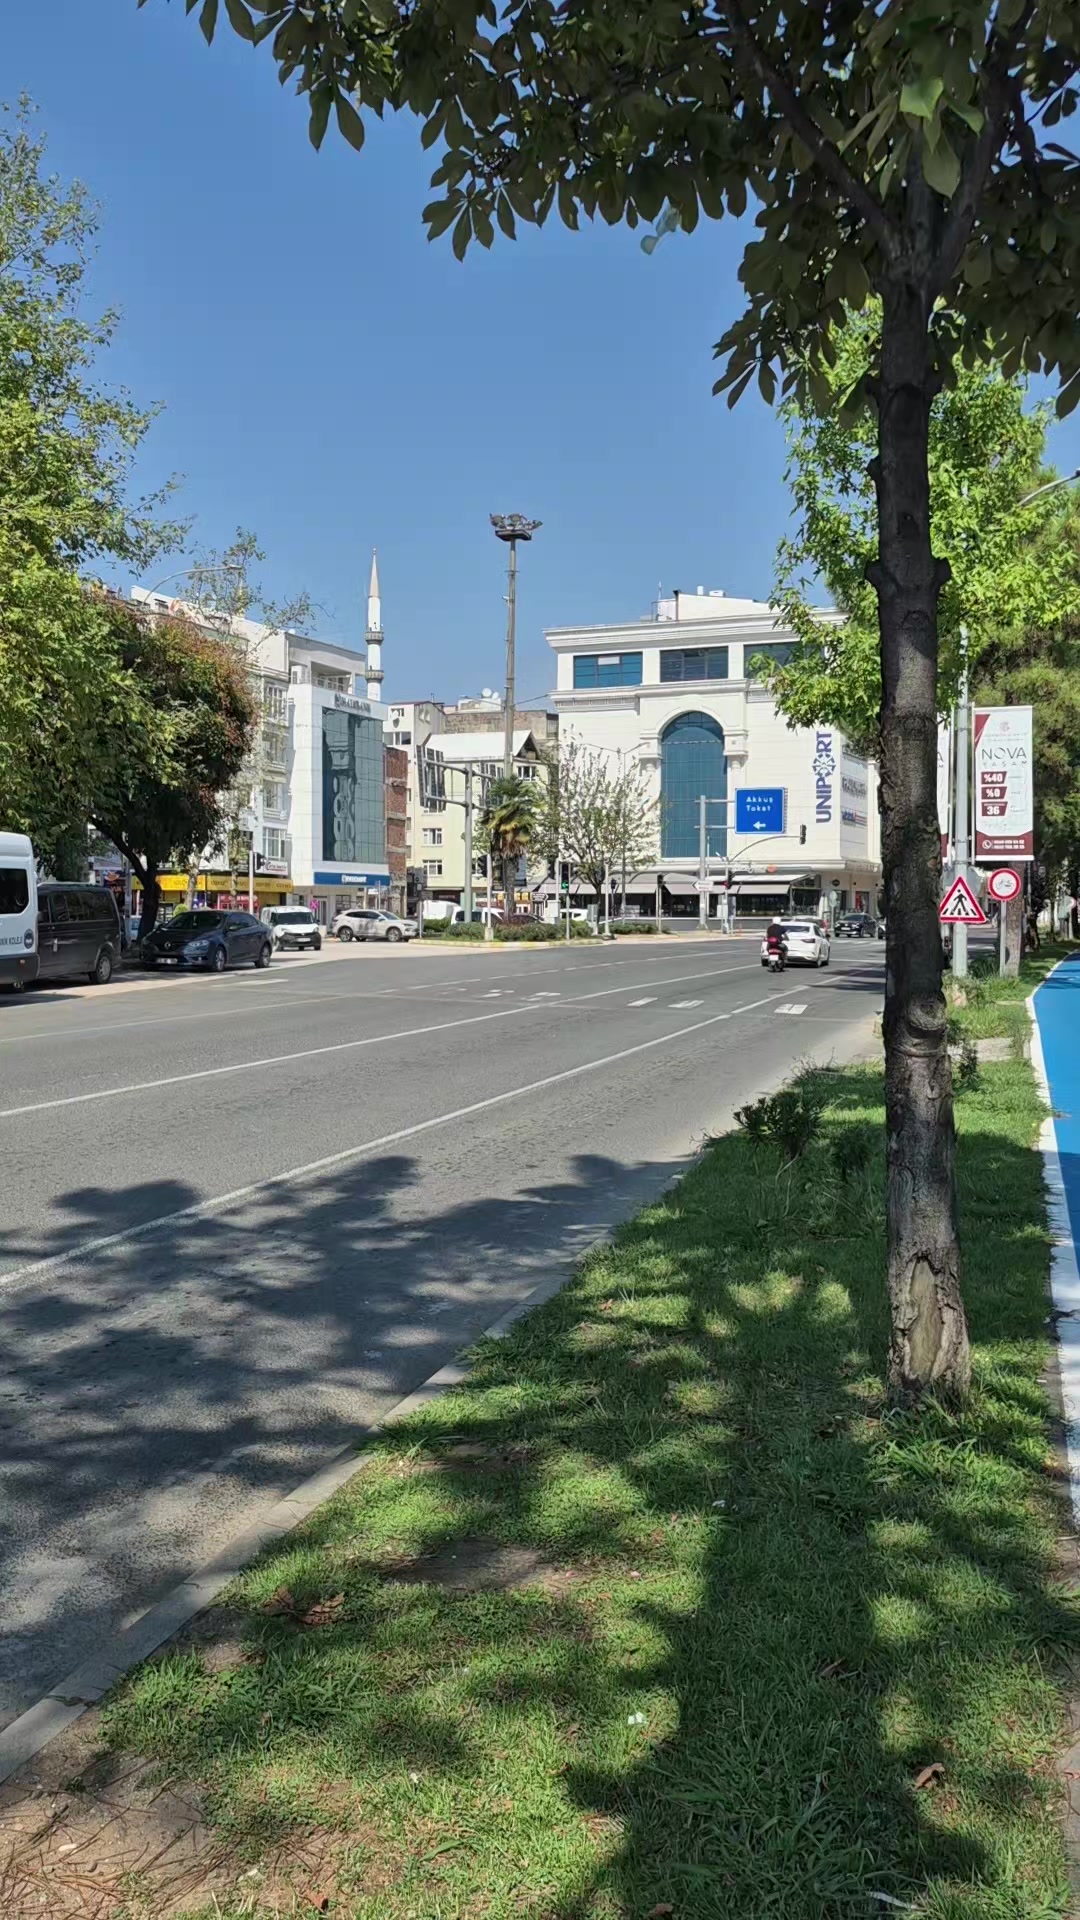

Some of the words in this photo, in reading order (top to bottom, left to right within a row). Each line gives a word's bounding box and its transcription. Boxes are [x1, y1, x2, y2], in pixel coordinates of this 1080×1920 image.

[981, 747, 1027, 760] NOVA
[983, 773, 1003, 783] %40
[985, 788, 1001, 798] %0
[986, 806, 1000, 815] 36
